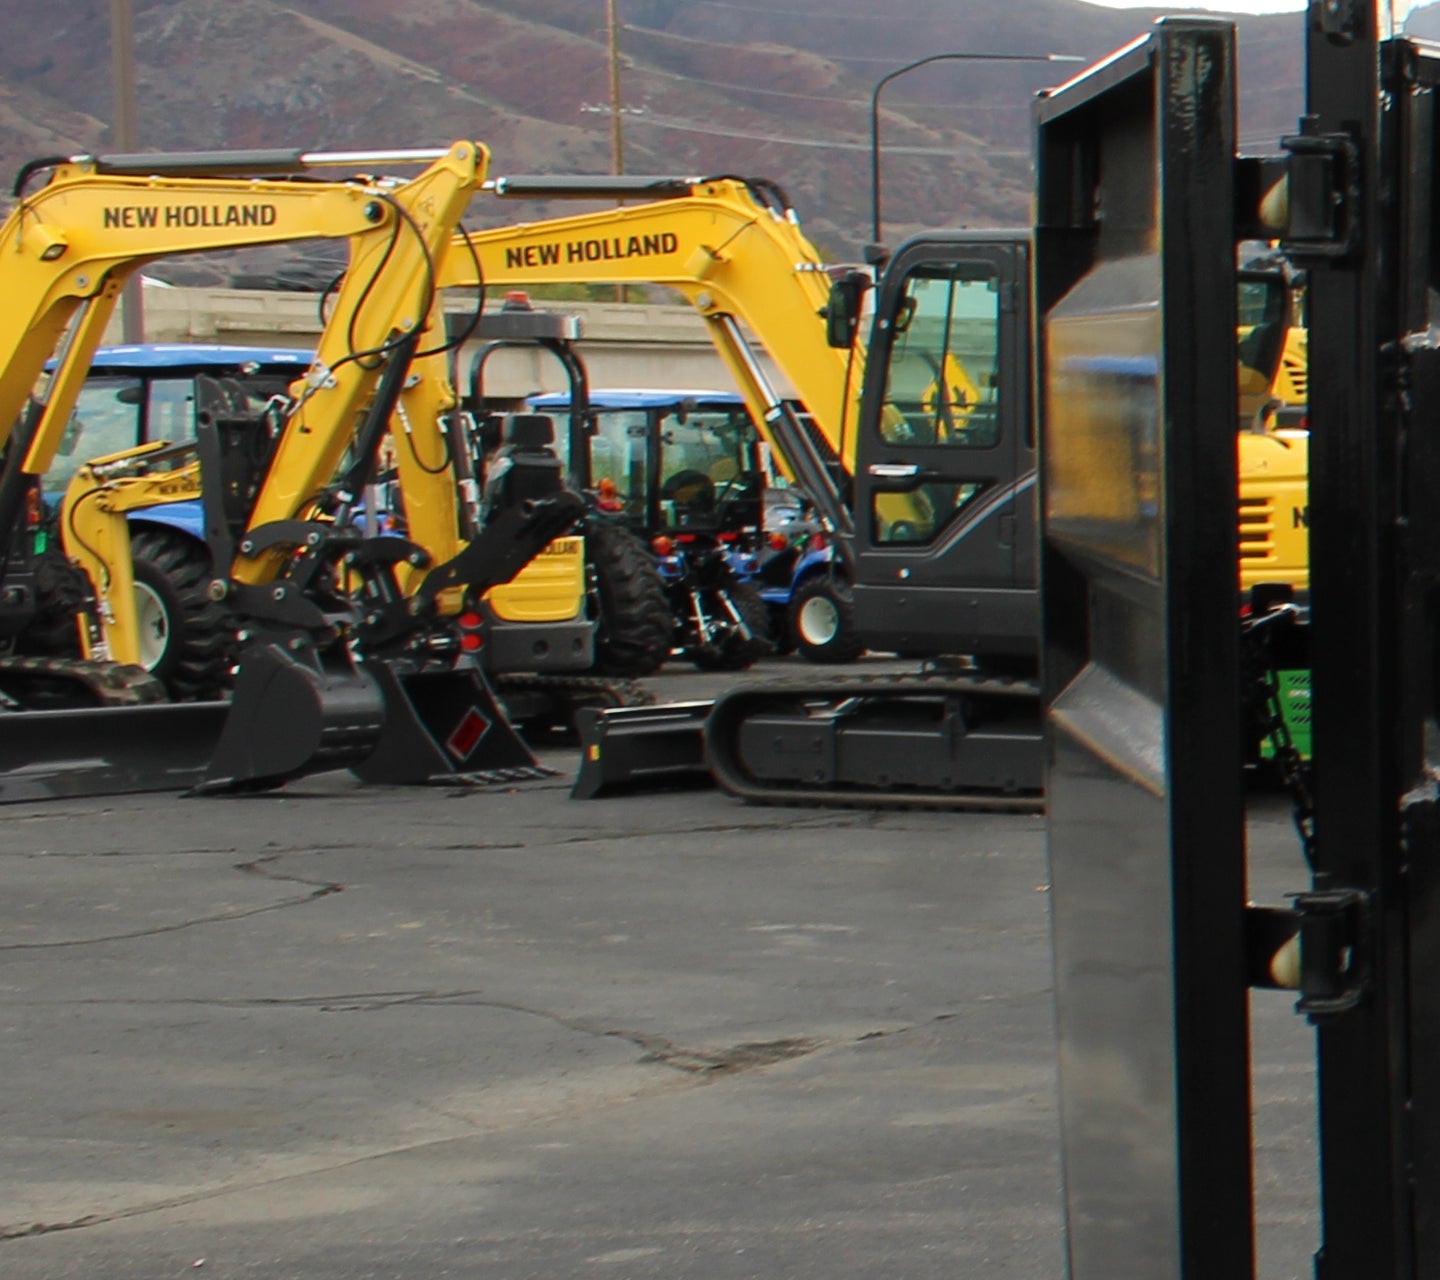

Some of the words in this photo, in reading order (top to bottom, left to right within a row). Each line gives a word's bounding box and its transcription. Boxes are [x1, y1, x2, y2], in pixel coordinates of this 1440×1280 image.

[104, 206, 158, 228] NEW
[165, 204, 278, 228] HOLLAND
[506, 243, 561, 269] NEW
[567, 232, 679, 263] HOLLAND
